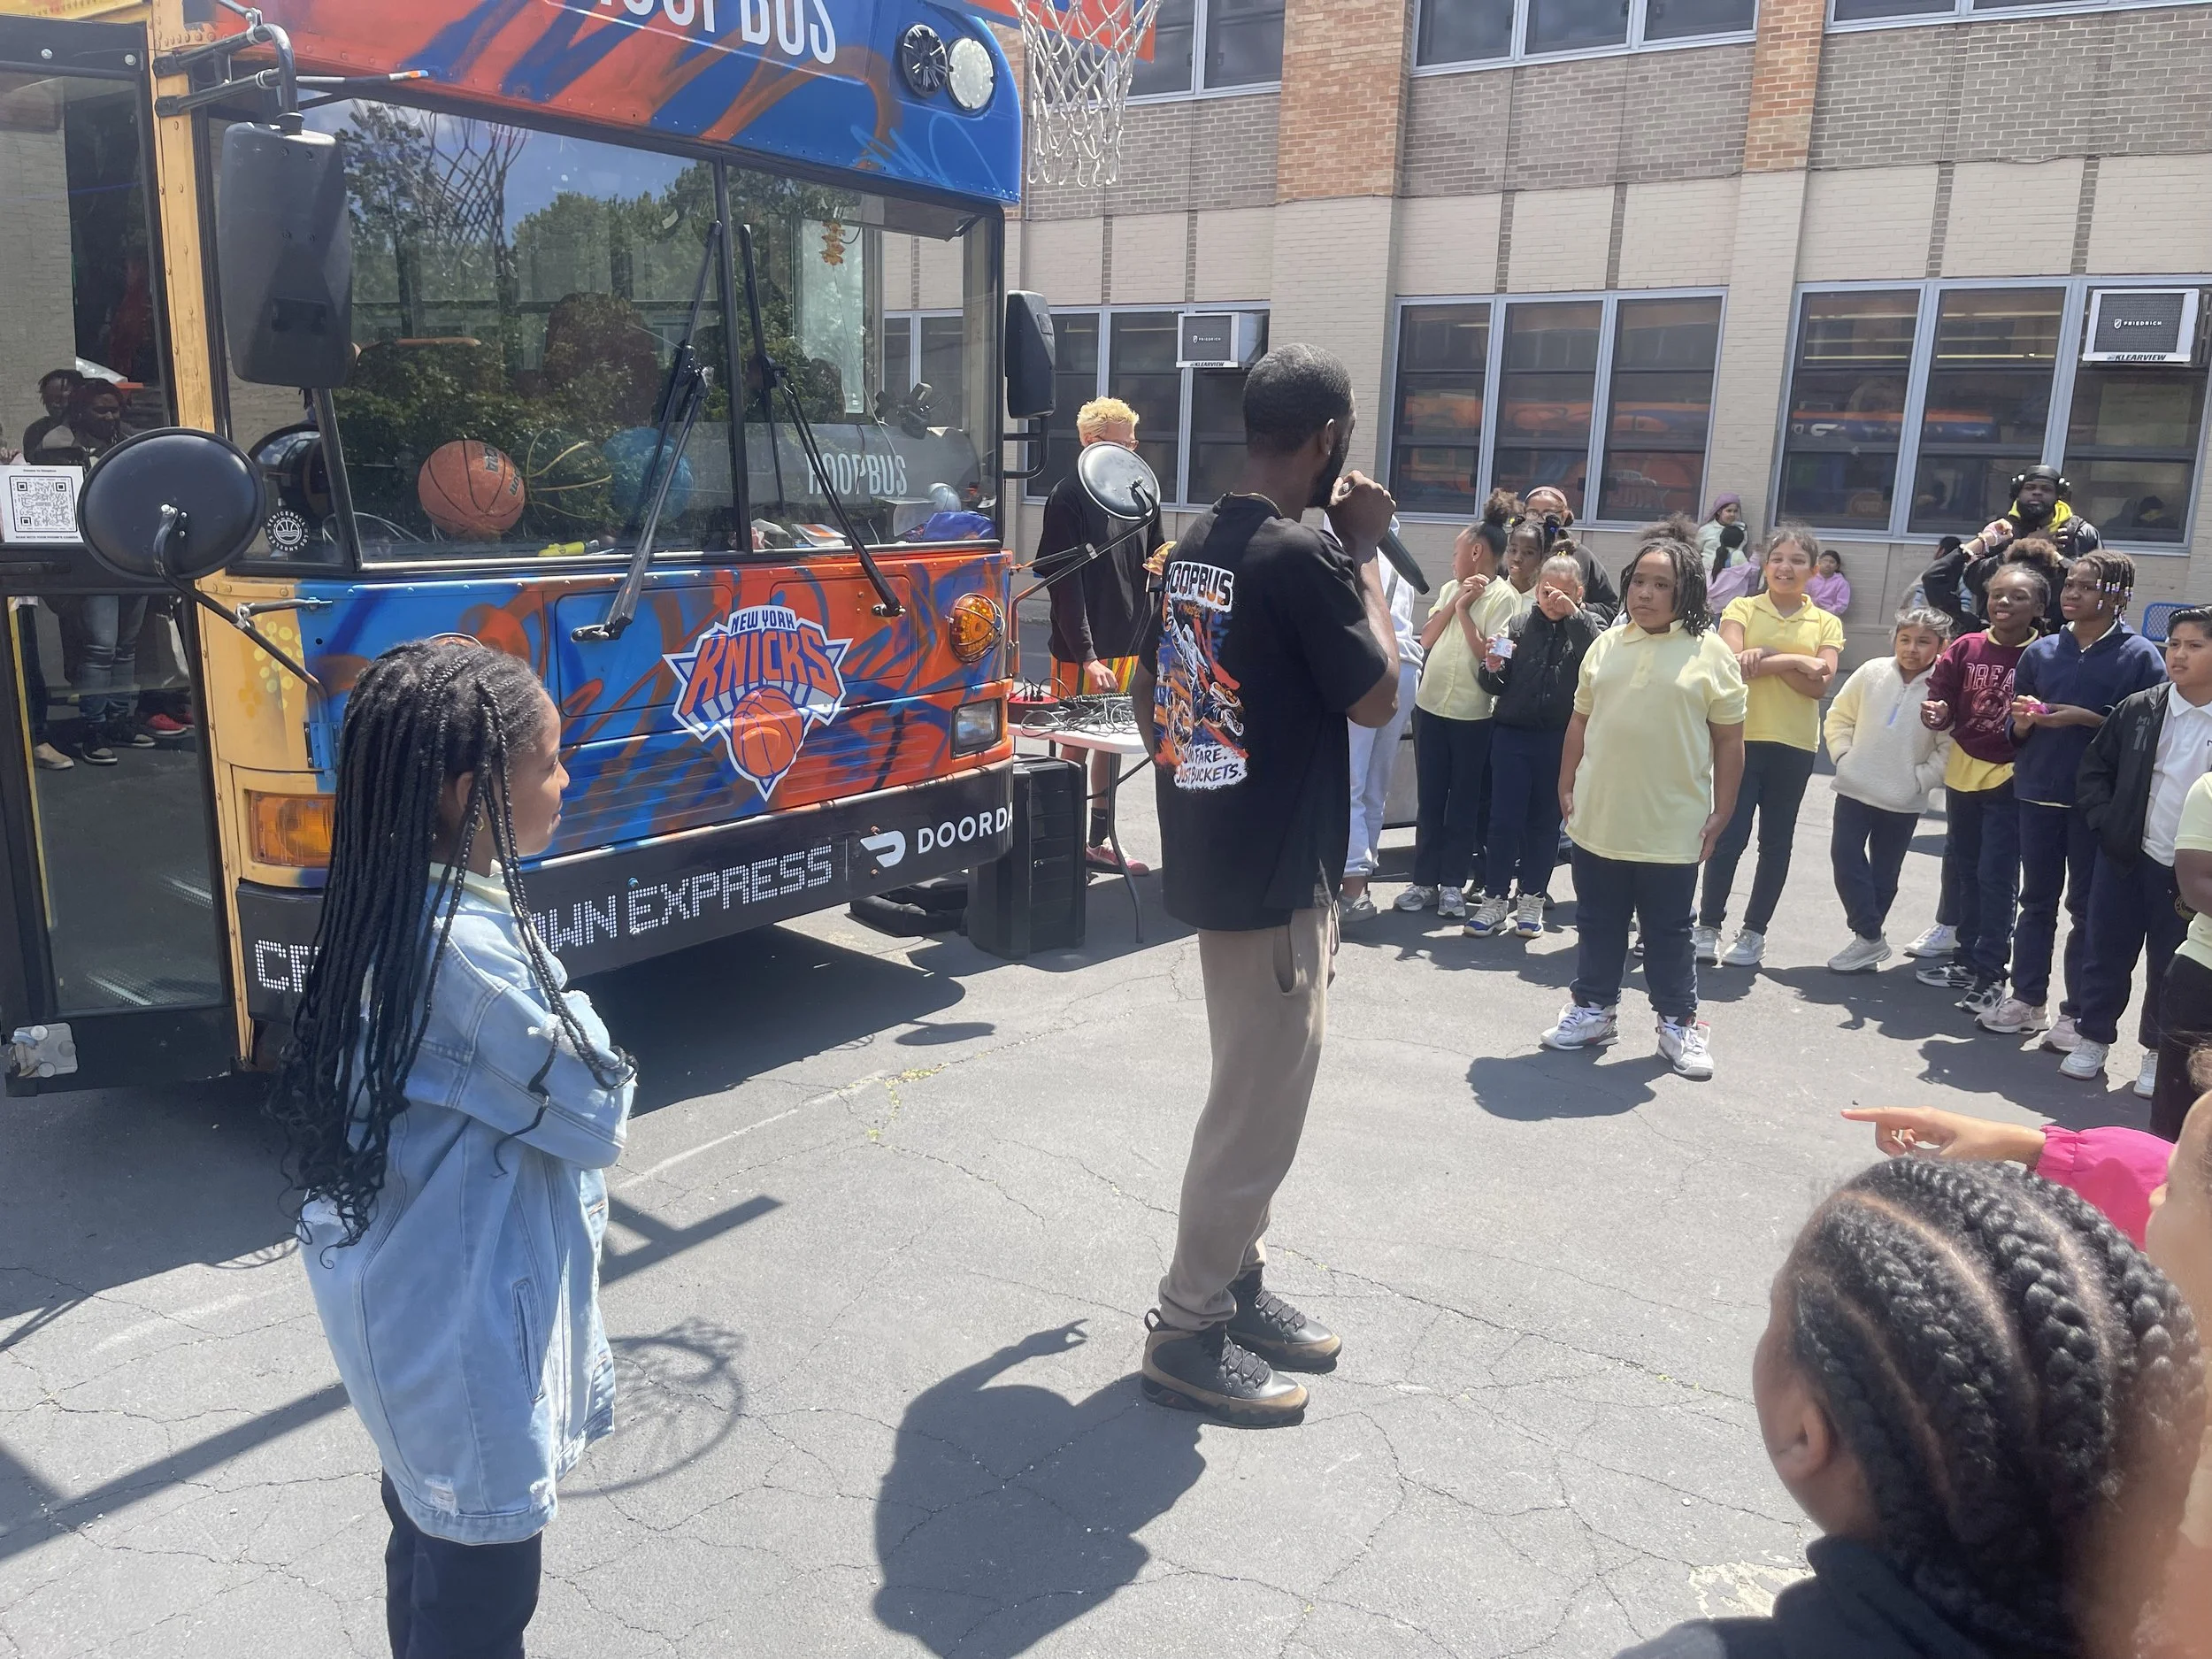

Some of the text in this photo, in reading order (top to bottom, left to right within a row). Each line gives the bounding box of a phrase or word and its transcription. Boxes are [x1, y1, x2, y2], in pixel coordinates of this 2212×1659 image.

[731, 610, 795, 634] NEW YORK
[680, 626, 841, 716] KNICKS
[1195, 748, 1227, 764] FARE.
[1191, 763, 1242, 784] BUCKETS.
[627, 844, 833, 930] EXPRESS
